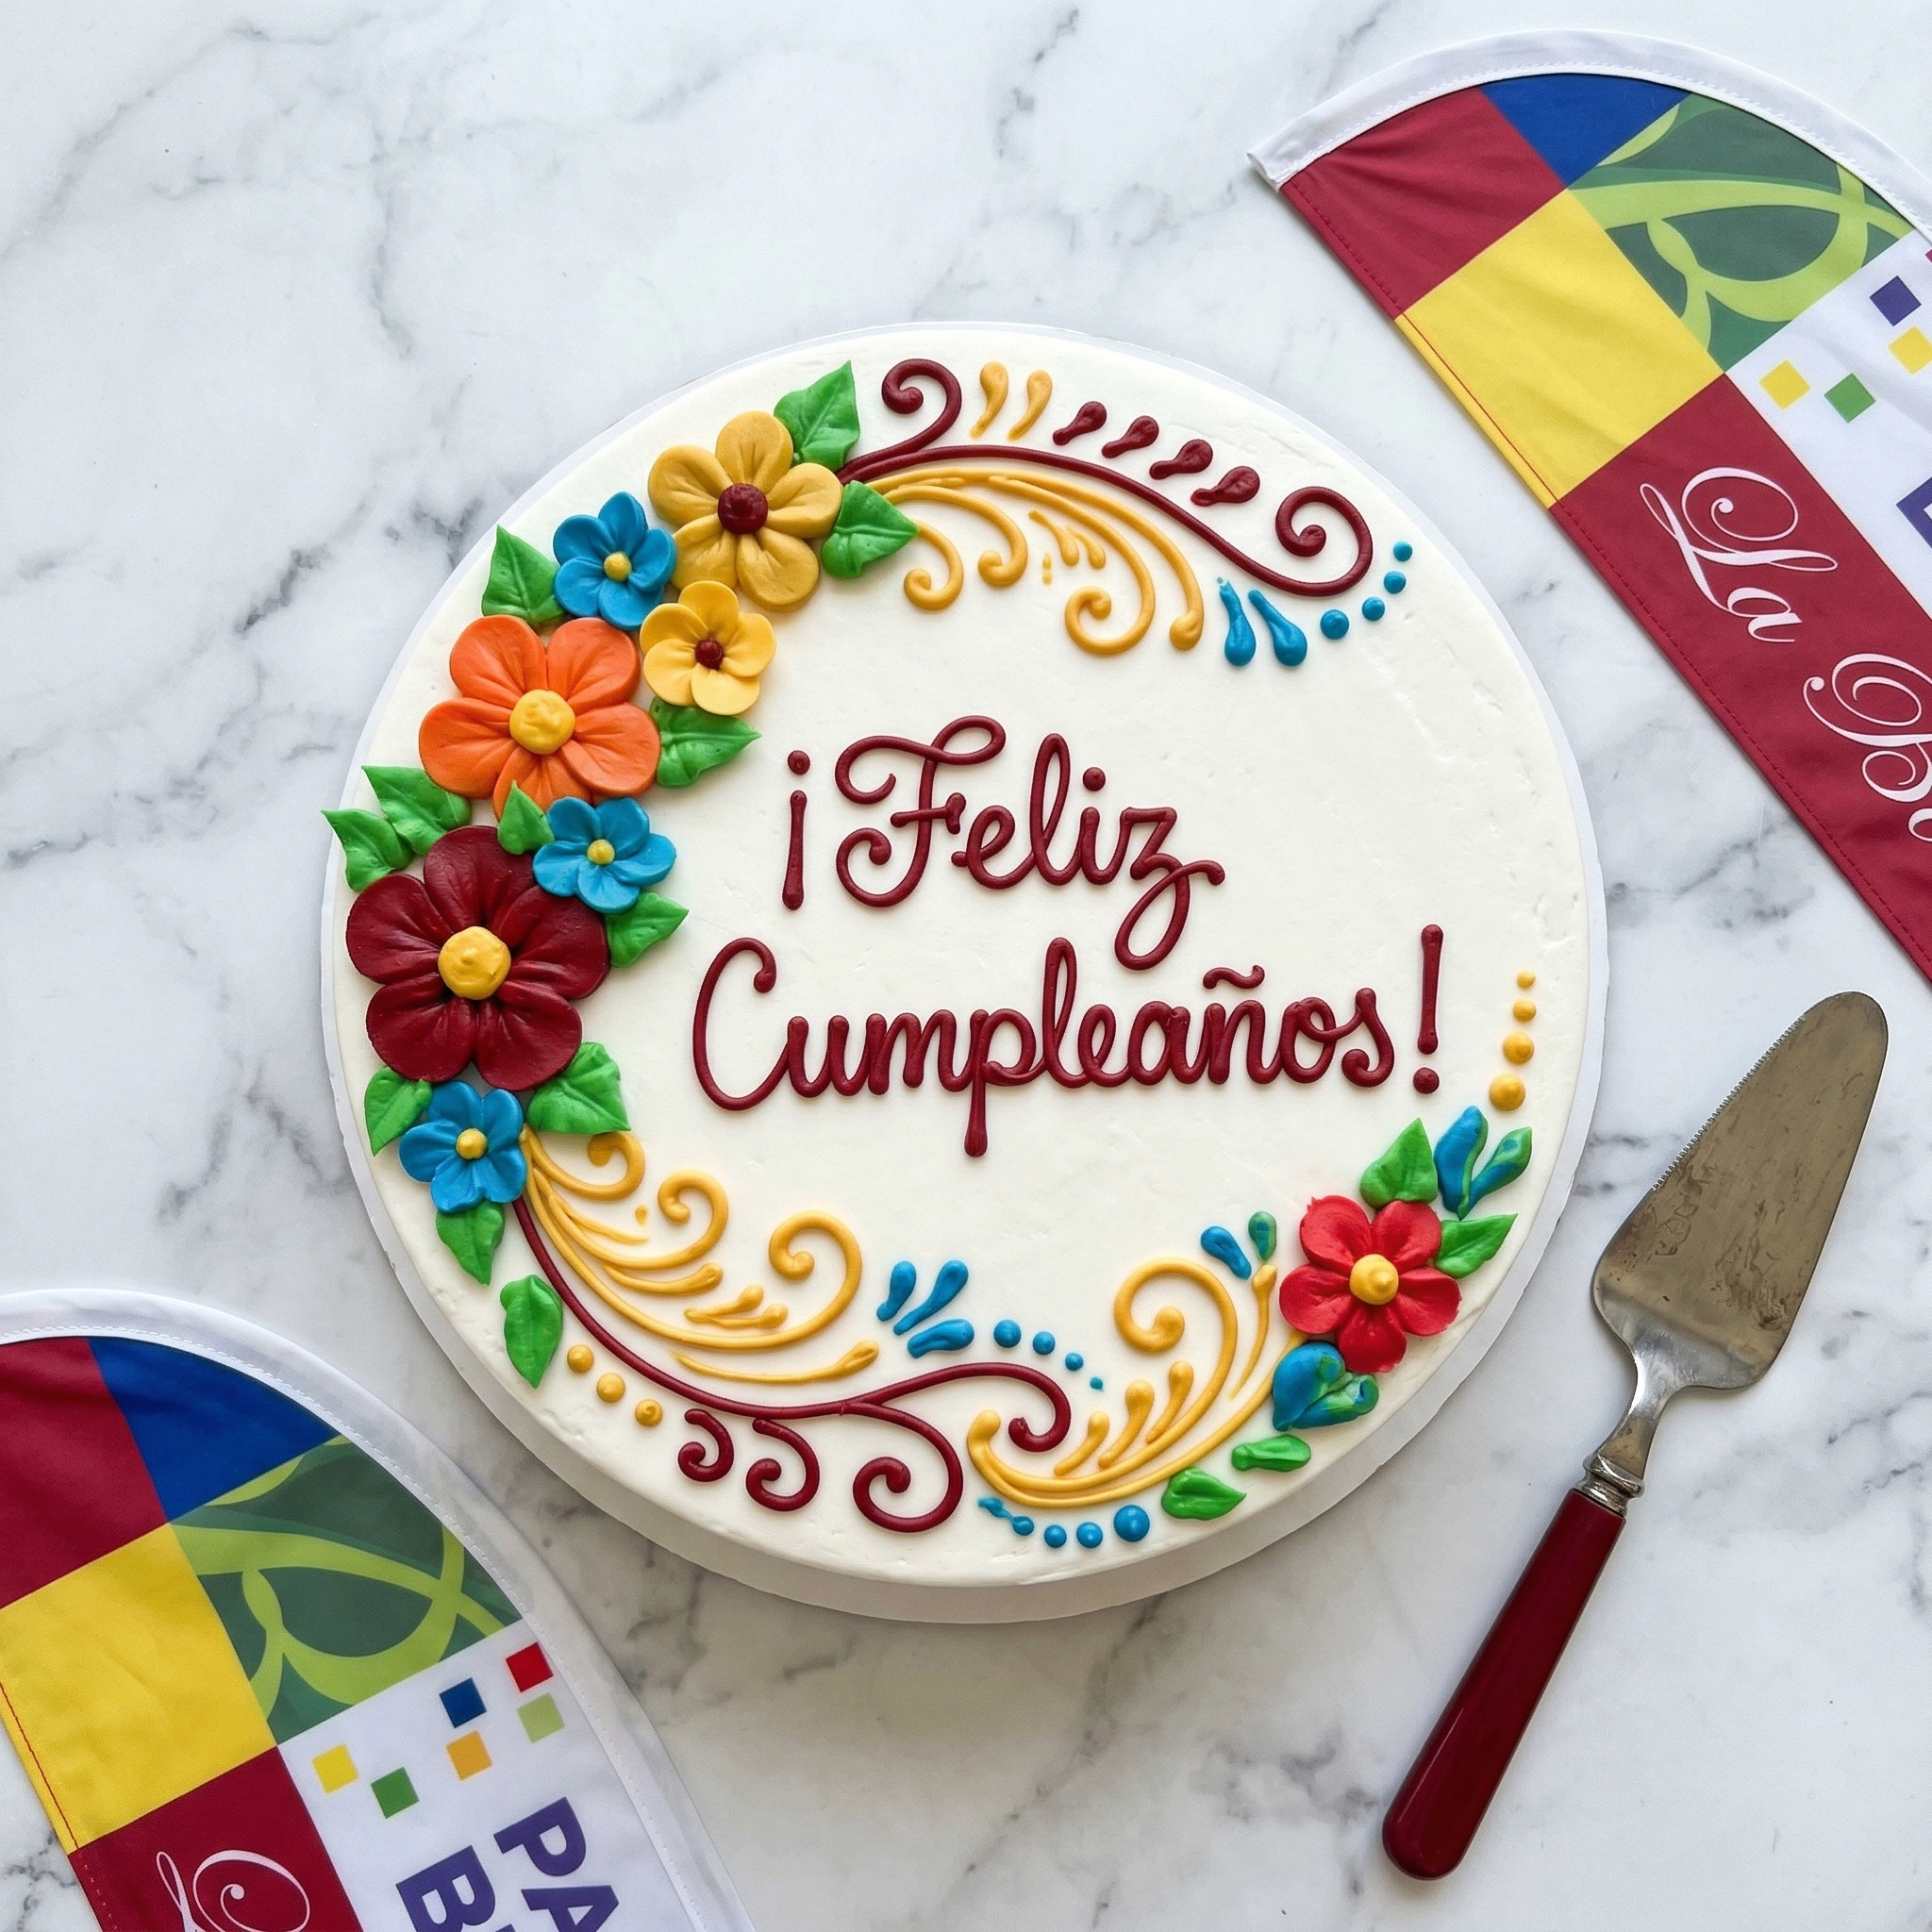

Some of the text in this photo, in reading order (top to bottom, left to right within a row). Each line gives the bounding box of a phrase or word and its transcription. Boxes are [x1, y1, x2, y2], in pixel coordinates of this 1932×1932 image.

[1640, 467, 1839, 642] La
[782, 716, 1224, 971] ¡Feliz
[692, 924, 1443, 1158] Cumpleaños!
[395, 1844, 516, 1932] B
